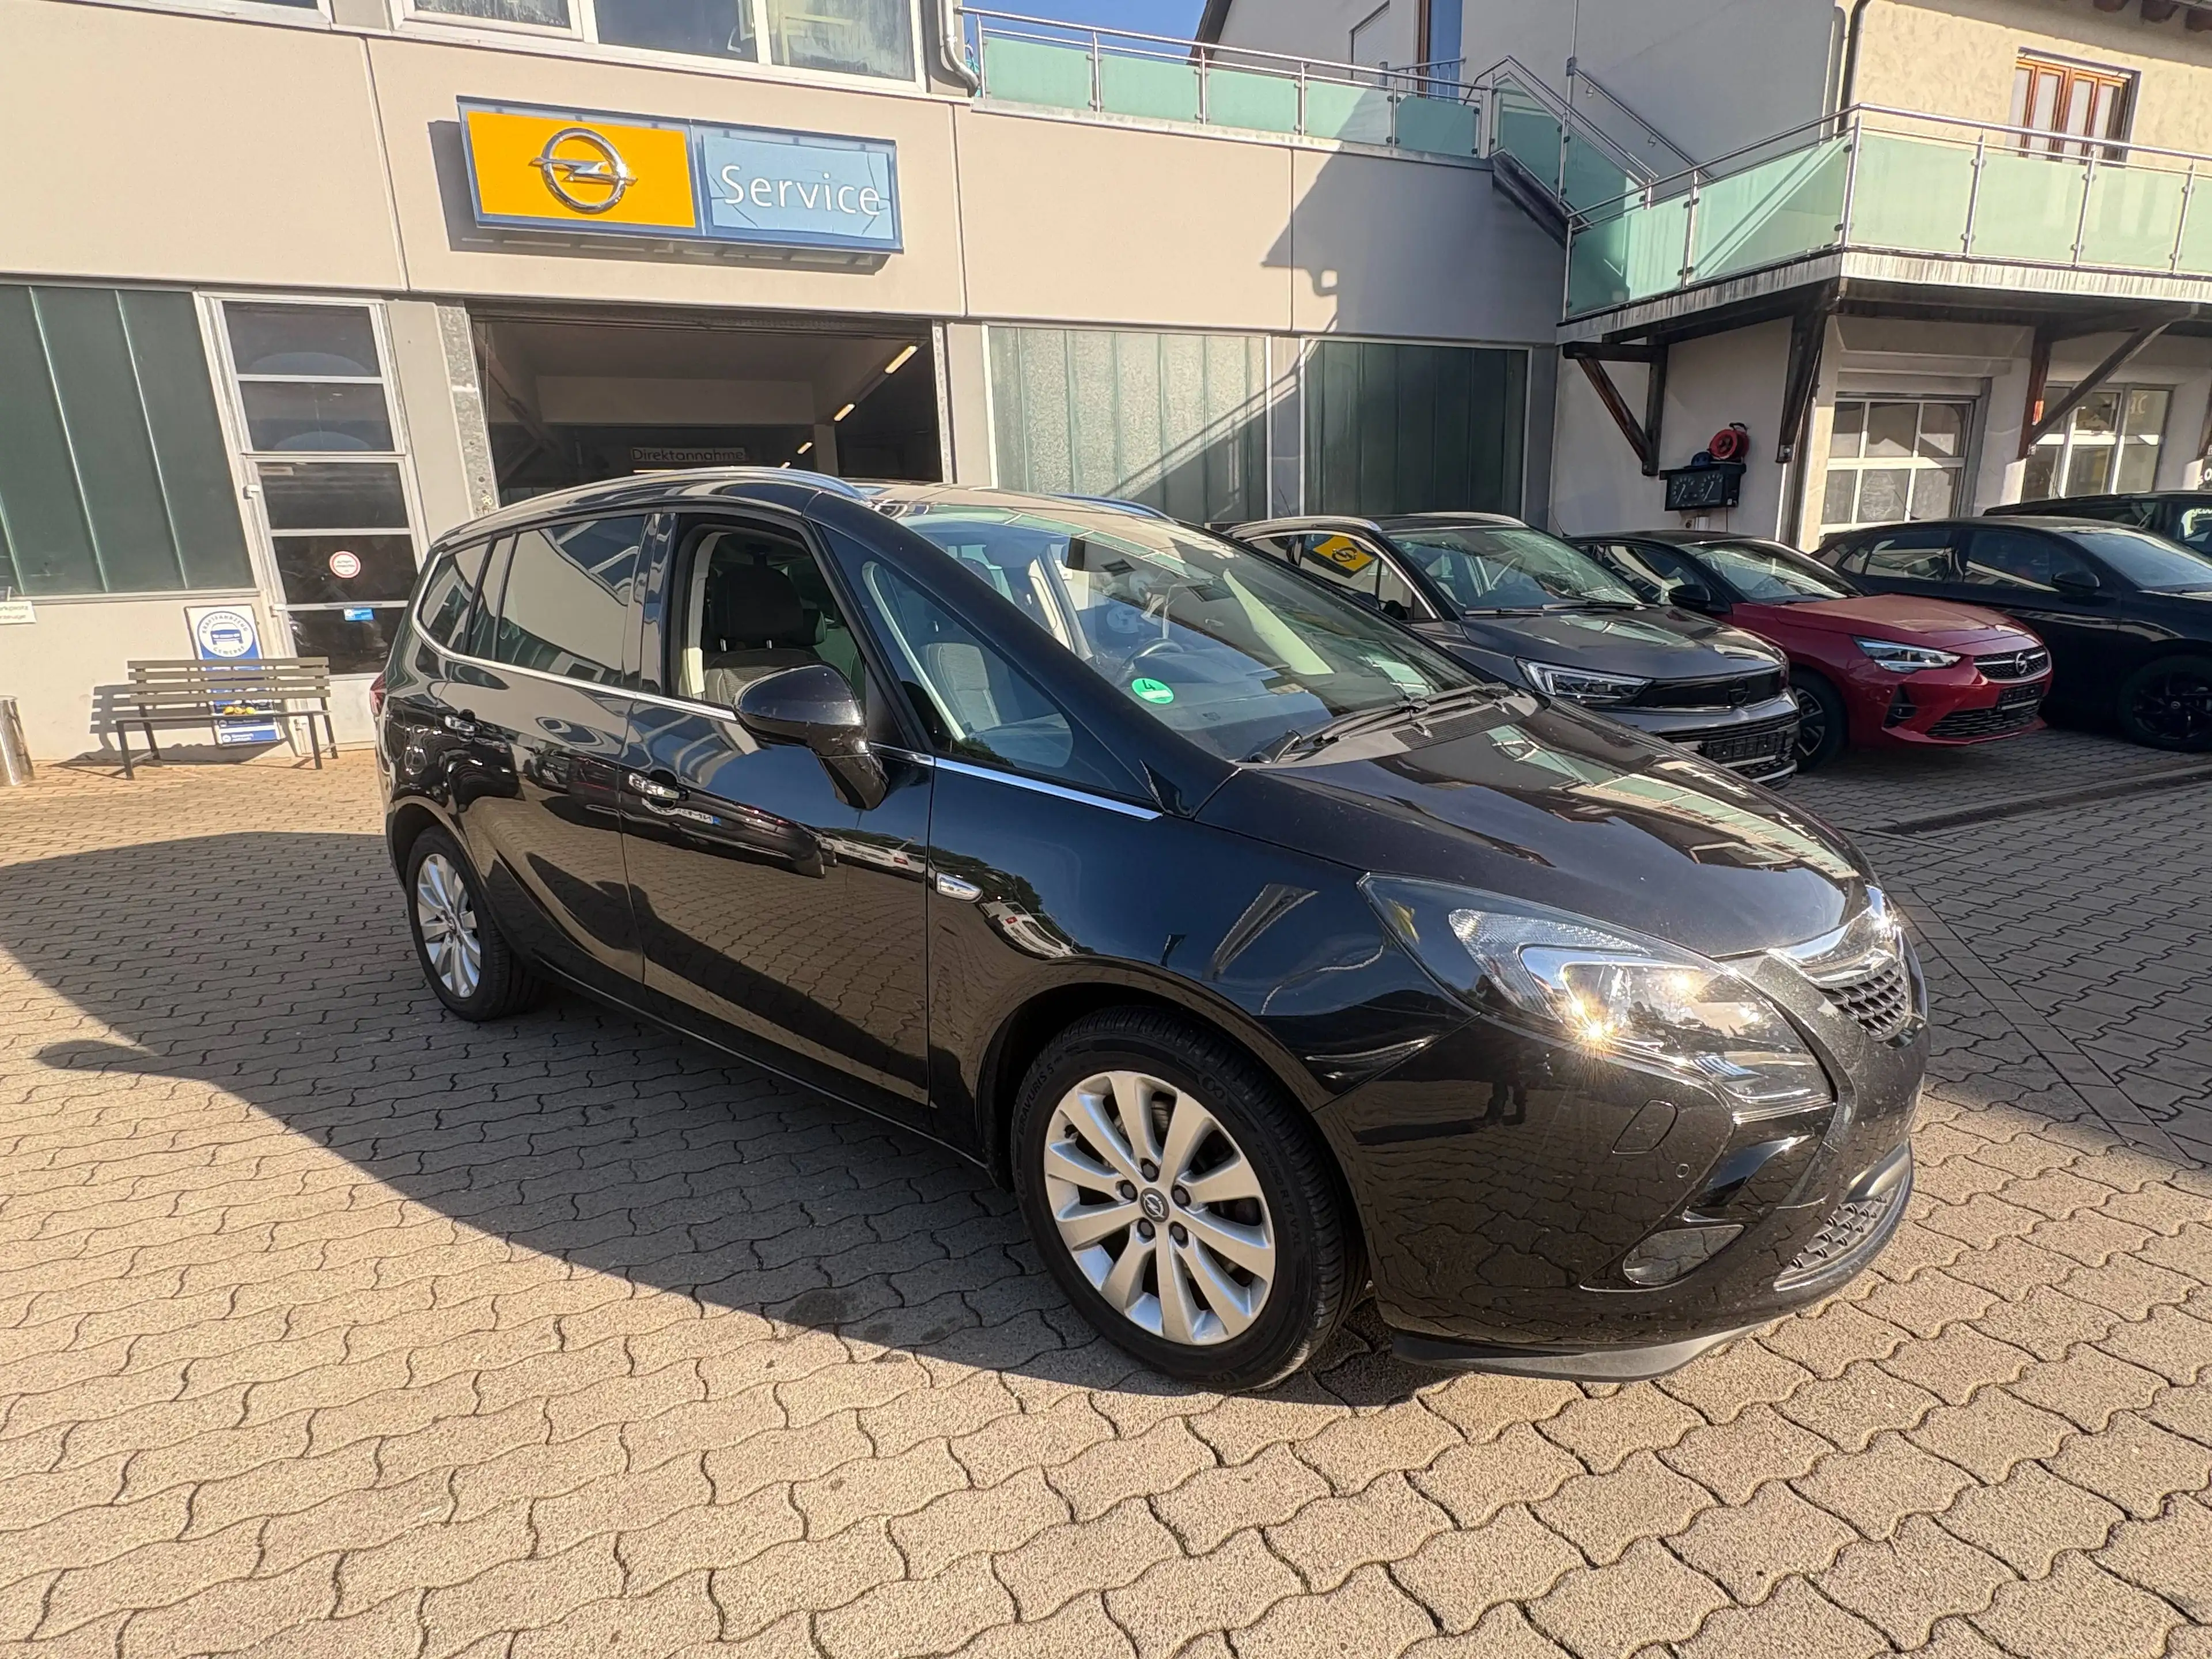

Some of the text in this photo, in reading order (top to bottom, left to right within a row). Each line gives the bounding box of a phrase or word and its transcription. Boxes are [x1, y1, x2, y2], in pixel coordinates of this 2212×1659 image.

[722, 165, 880, 215] Service
[634, 449, 744, 460] Direktannahme
[1142, 680, 1156, 690] 4
